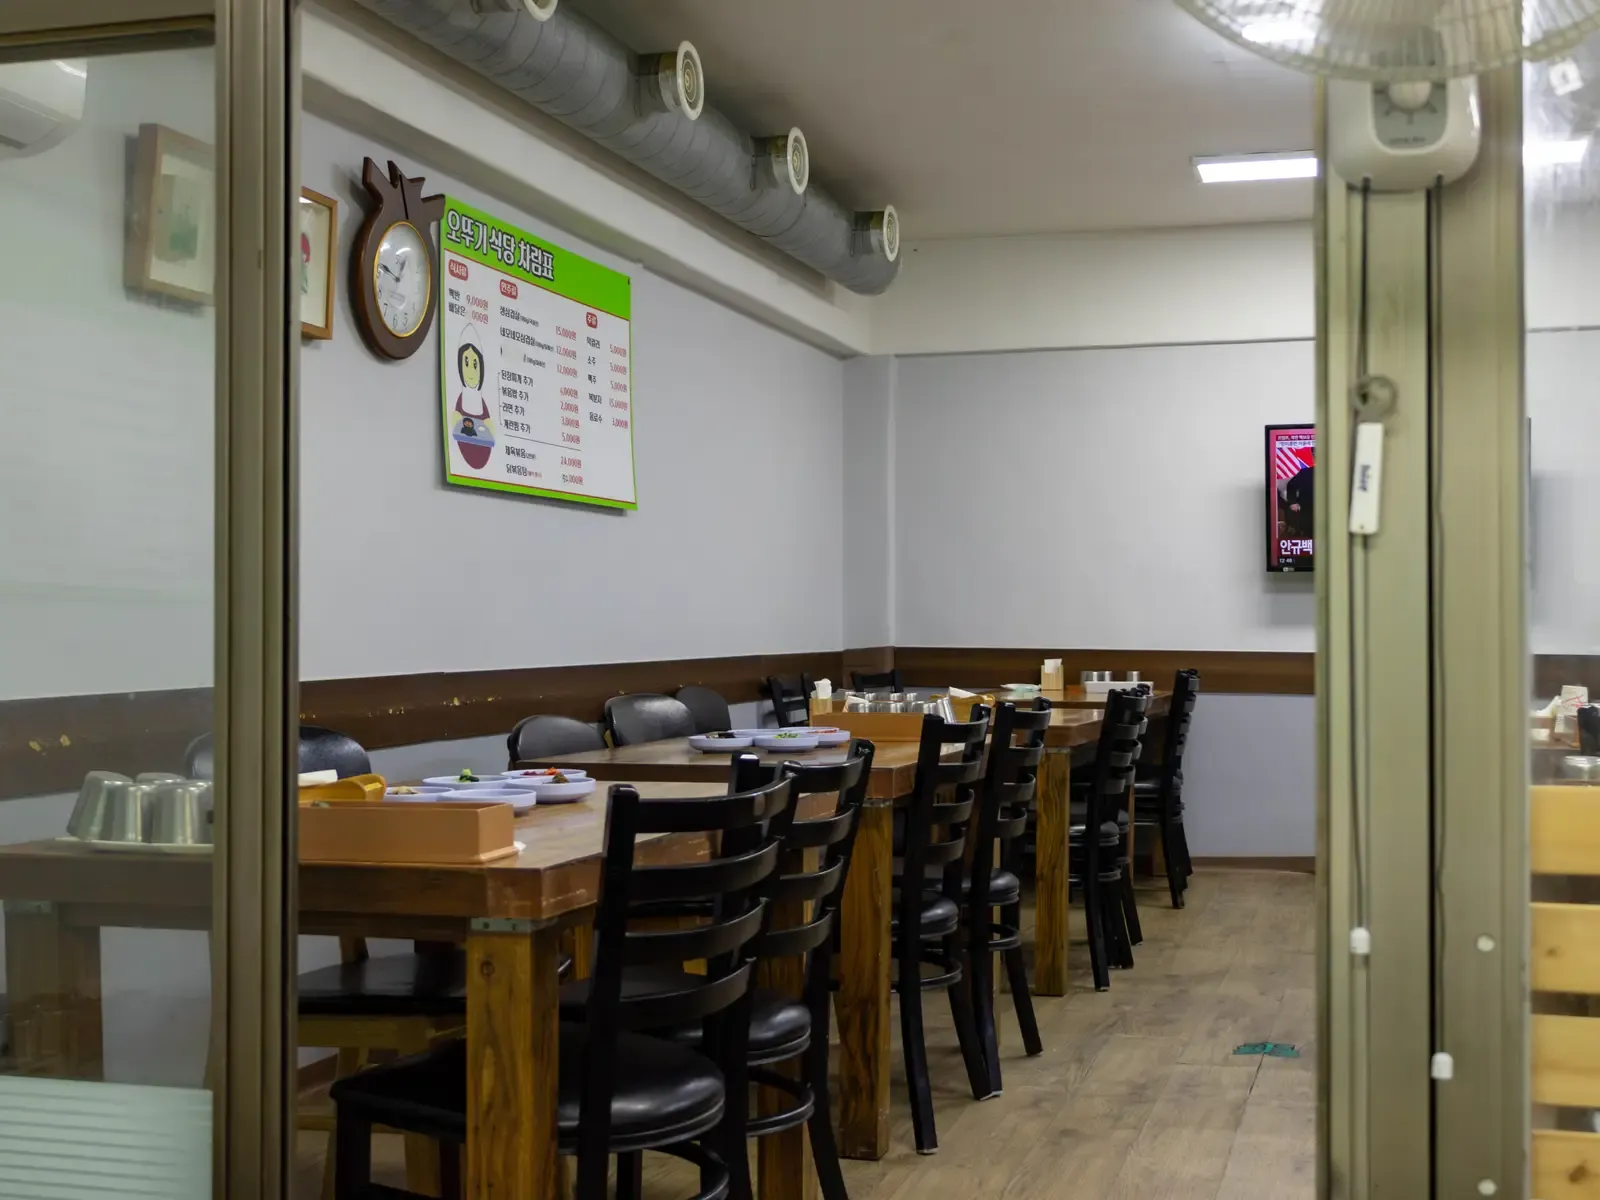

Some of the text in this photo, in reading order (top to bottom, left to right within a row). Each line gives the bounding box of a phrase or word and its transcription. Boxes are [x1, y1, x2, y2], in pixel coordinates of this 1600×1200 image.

[446, 208, 554, 281] 오뚜기 식당 차림표
[448, 287, 489, 311] 백반 9,000원
[555, 325, 577, 341] 15,000원
[587, 356, 596, 366] 소주
[523, 375, 534, 387] 추가
[518, 390, 529, 402] 추가
[502, 402, 525, 416] 라면 추가
[520, 422, 531, 434] 추가
[1280, 539, 1313, 555] 안규백
